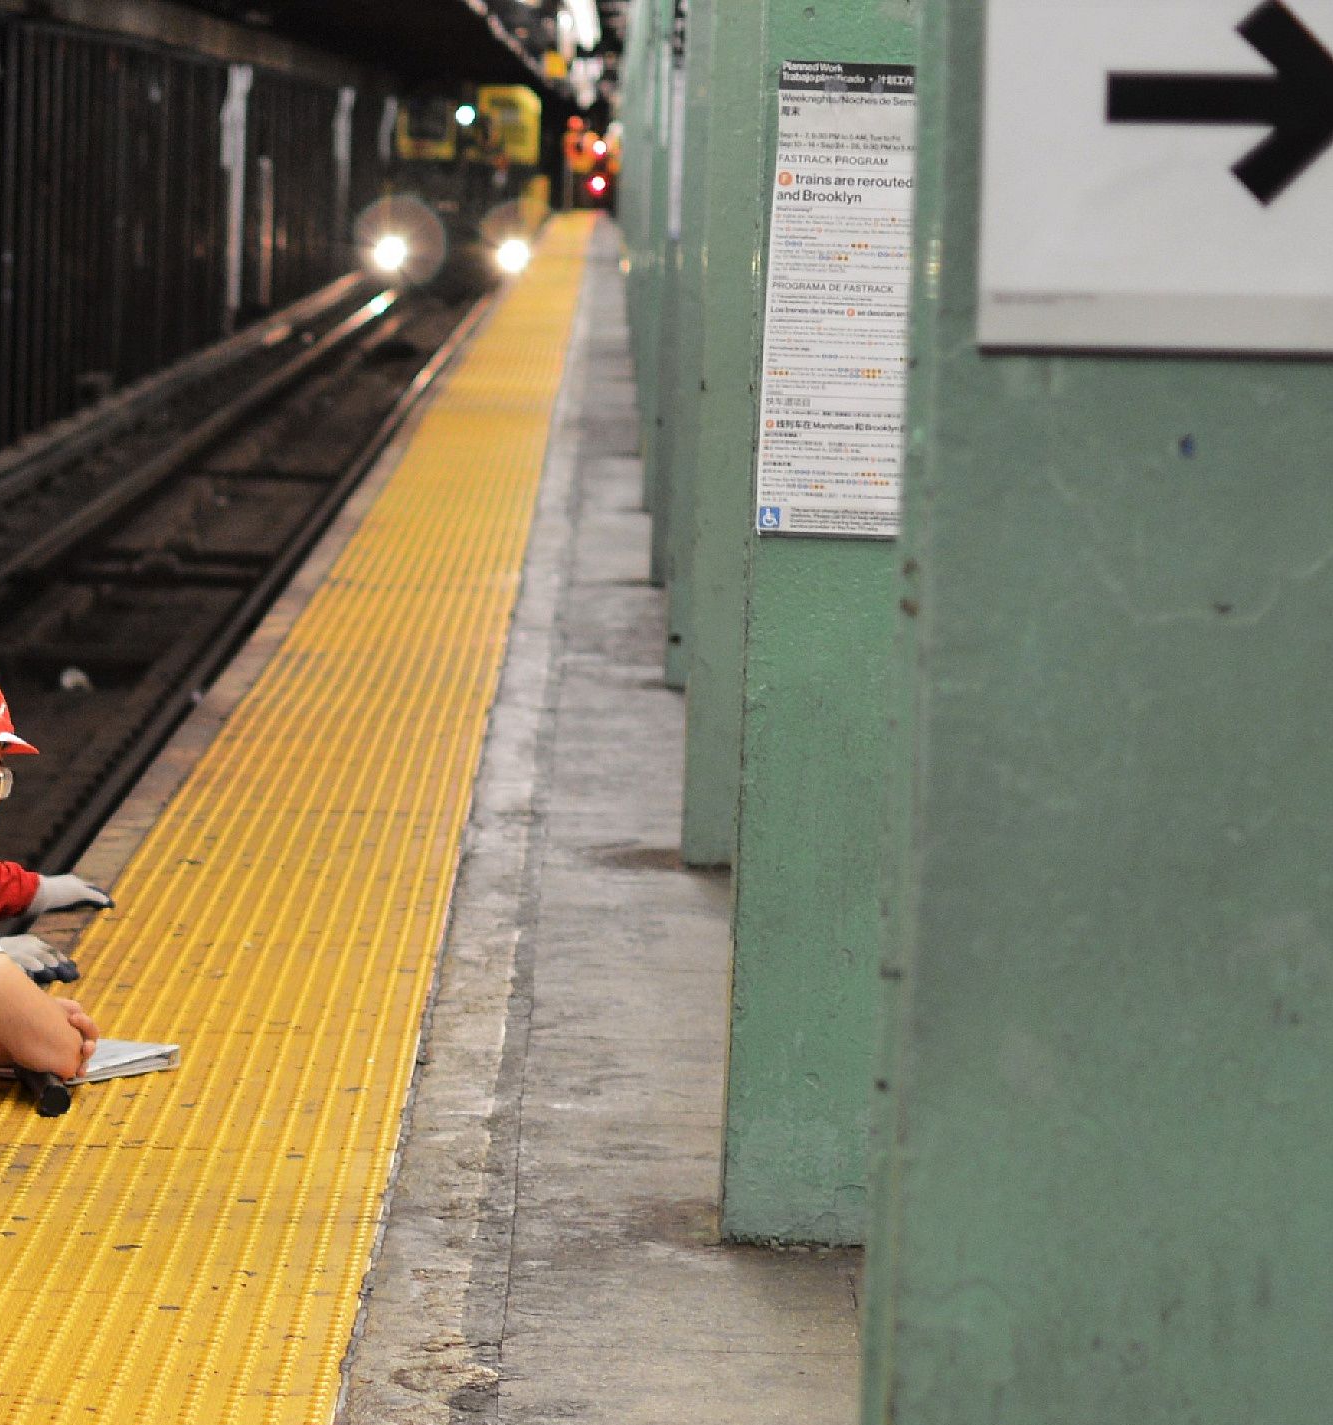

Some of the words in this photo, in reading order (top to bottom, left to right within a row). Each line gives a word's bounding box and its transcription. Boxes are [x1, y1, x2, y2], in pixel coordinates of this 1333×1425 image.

[783, 61, 819, 71] Planned
[820, 63, 843, 73] Work
[778, 154, 832, 164] FASTRACK
[835, 155, 889, 166] PROGRAM
[796, 174, 832, 186] trains
[835, 177, 855, 186] are
[858, 176, 912, 188] rerouted
[777, 189, 799, 200] and
[803, 190, 861, 205] Brooklyn
[772, 281, 826, 291] PROGRAMA
[829, 283, 840, 292] DE
[844, 283, 894, 294] FASTRACK
